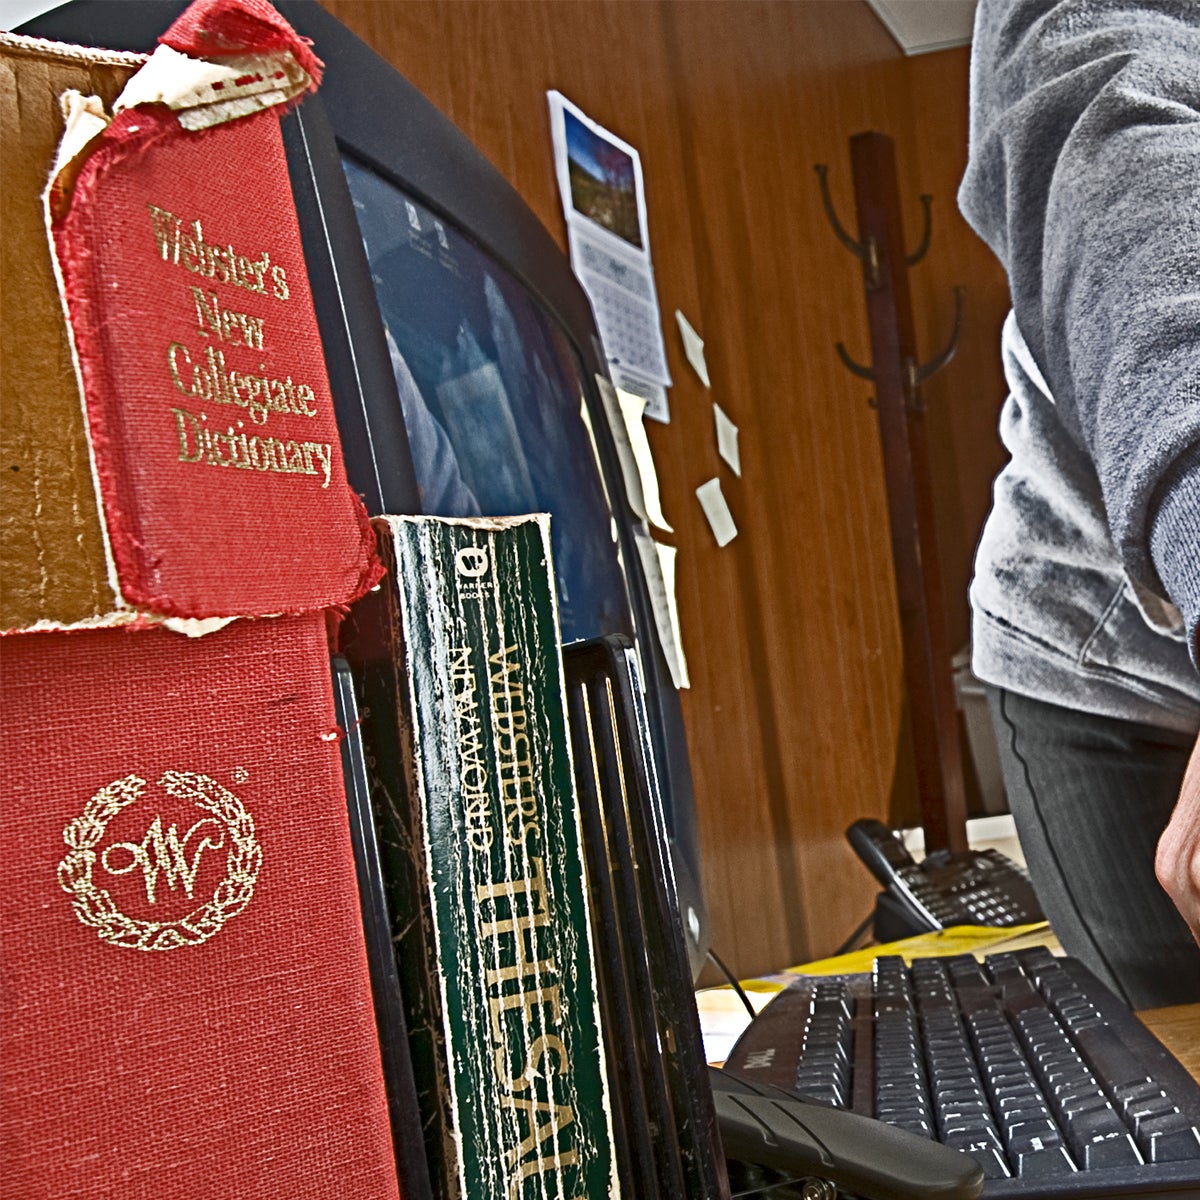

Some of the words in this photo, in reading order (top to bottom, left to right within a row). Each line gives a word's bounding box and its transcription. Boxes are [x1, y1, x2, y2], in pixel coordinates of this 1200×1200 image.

[147, 203, 290, 301] Webster's
[189, 285, 265, 351] New
[167, 342, 318, 426] Collegiate
[170, 407, 332, 489] Dictionary
[448, 646, 480, 723] NEW
[458, 723, 495, 850] WORLD
[488, 643, 543, 847] WEBSTER'S
